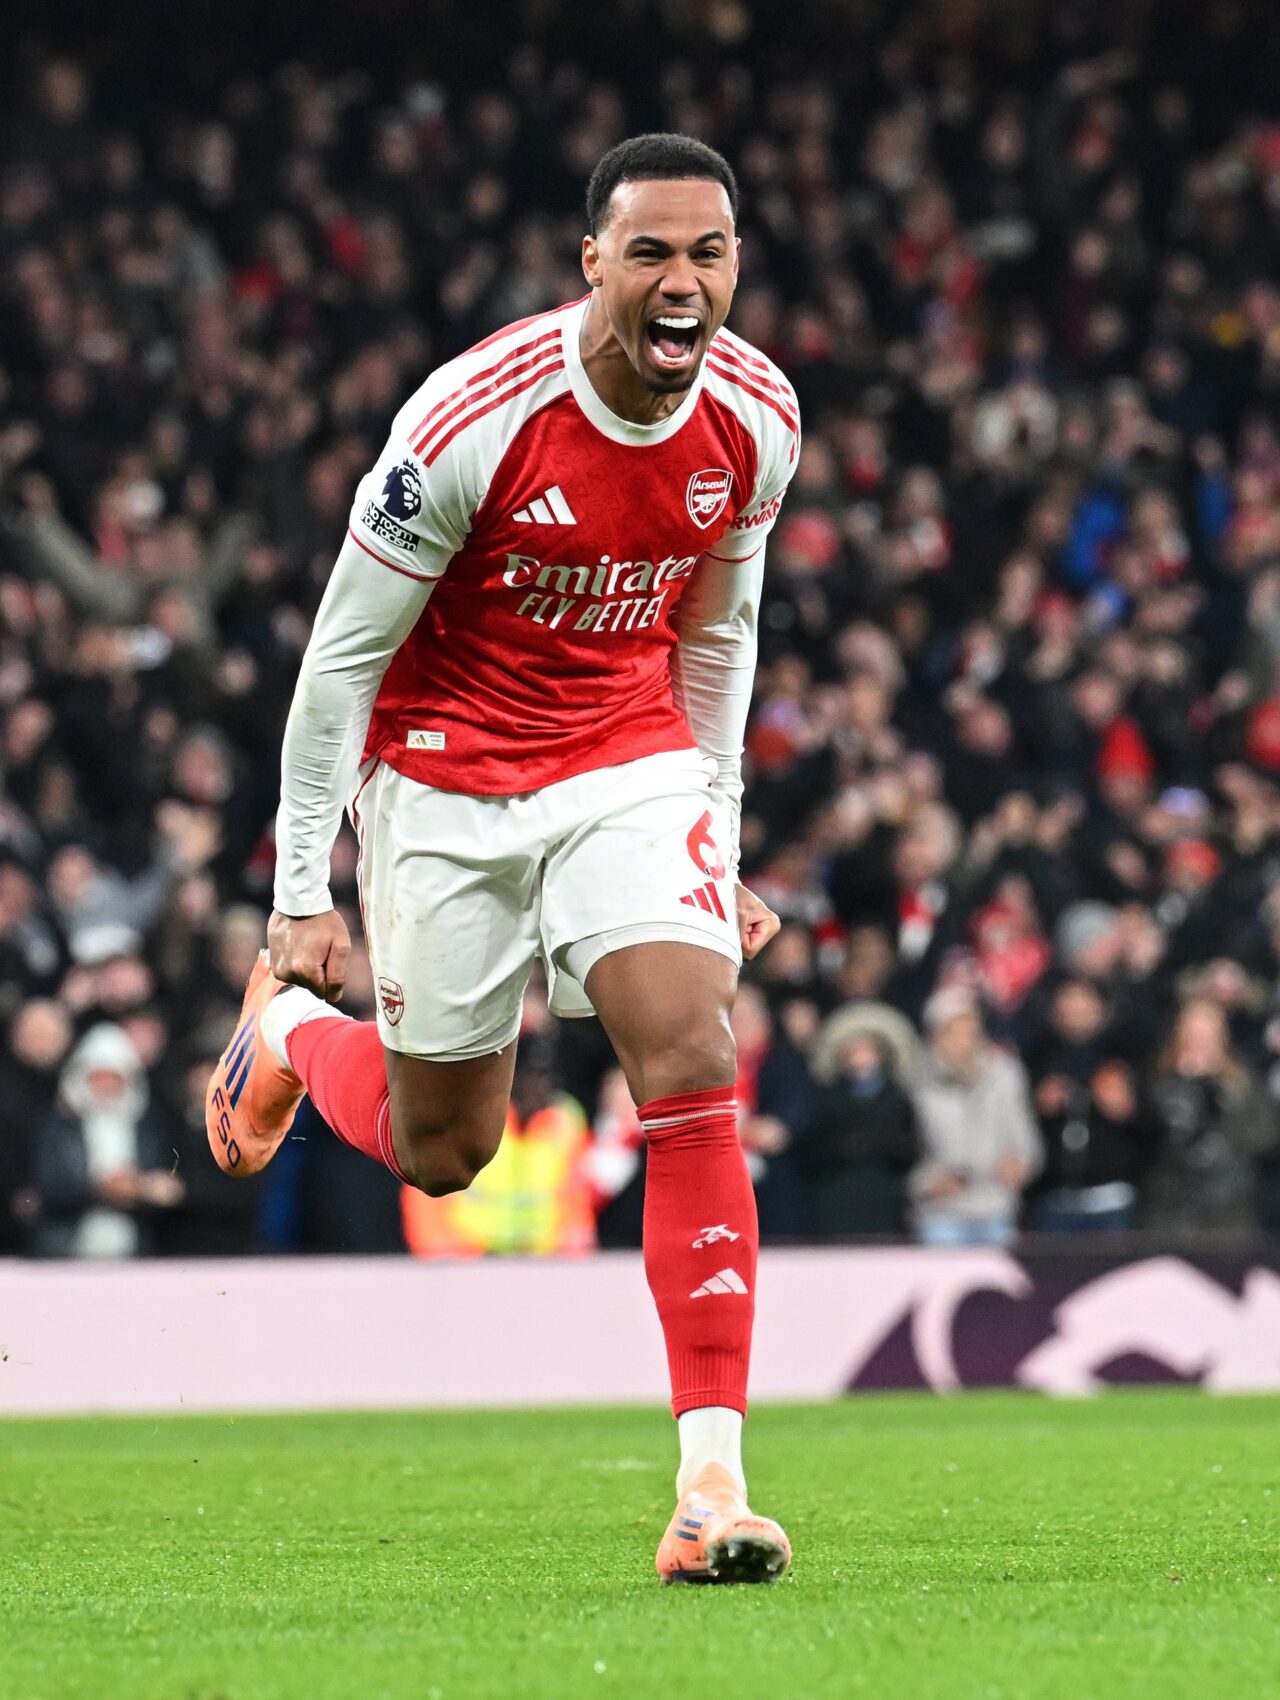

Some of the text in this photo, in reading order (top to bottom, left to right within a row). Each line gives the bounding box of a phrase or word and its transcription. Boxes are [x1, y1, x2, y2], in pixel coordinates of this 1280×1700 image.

[694, 478, 727, 491] Arsenal
[364, 500, 413, 541] No room
[375, 525, 417, 552] racism
[515, 592, 576, 630] FLY
[686, 808, 727, 881] 6
